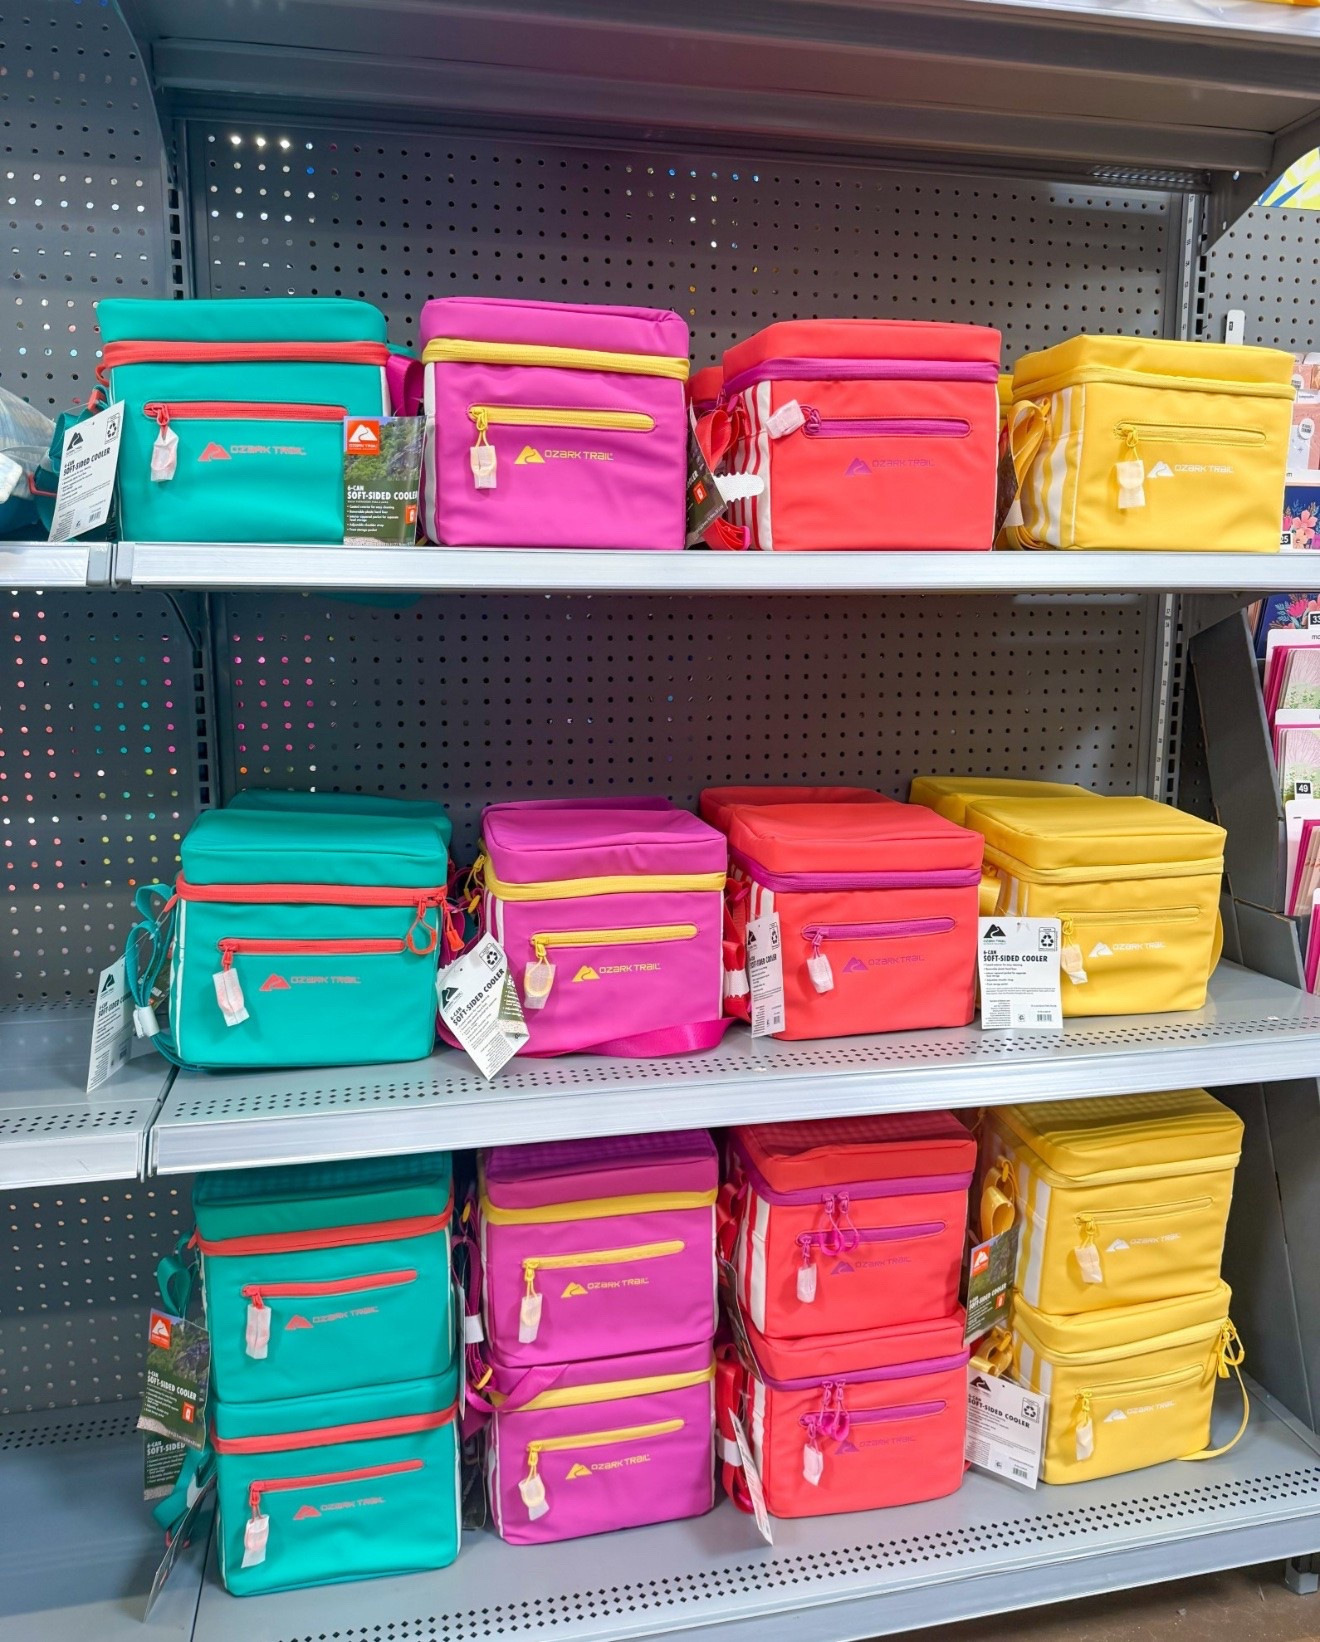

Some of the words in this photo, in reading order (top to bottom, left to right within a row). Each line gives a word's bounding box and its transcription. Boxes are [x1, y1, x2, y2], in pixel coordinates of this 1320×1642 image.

[544, 449, 581, 459] OZARK
[583, 451, 614, 461] TRAIL
[347, 491, 391, 500] SOFT-SIDED
[1298, 783, 1309, 793] 49
[599, 965, 633, 974] OZARK
[634, 963, 661, 972] TRAIL
[452, 991, 484, 1026] SOFT-SIDED
[483, 968, 505, 992] COOLER
[587, 1280, 620, 1290] OZARK
[622, 1277, 649, 1286] TRAIL
[176, 1386, 197, 1401] COOLER
[968, 1397, 1003, 1416] SOFT-SIDED
[1004, 1413, 1030, 1429] COOLER
[147, 1442, 186, 1456] SOFT-SIDED
[591, 1460, 623, 1470] OZARK
[624, 1454, 651, 1466] TRAIL
